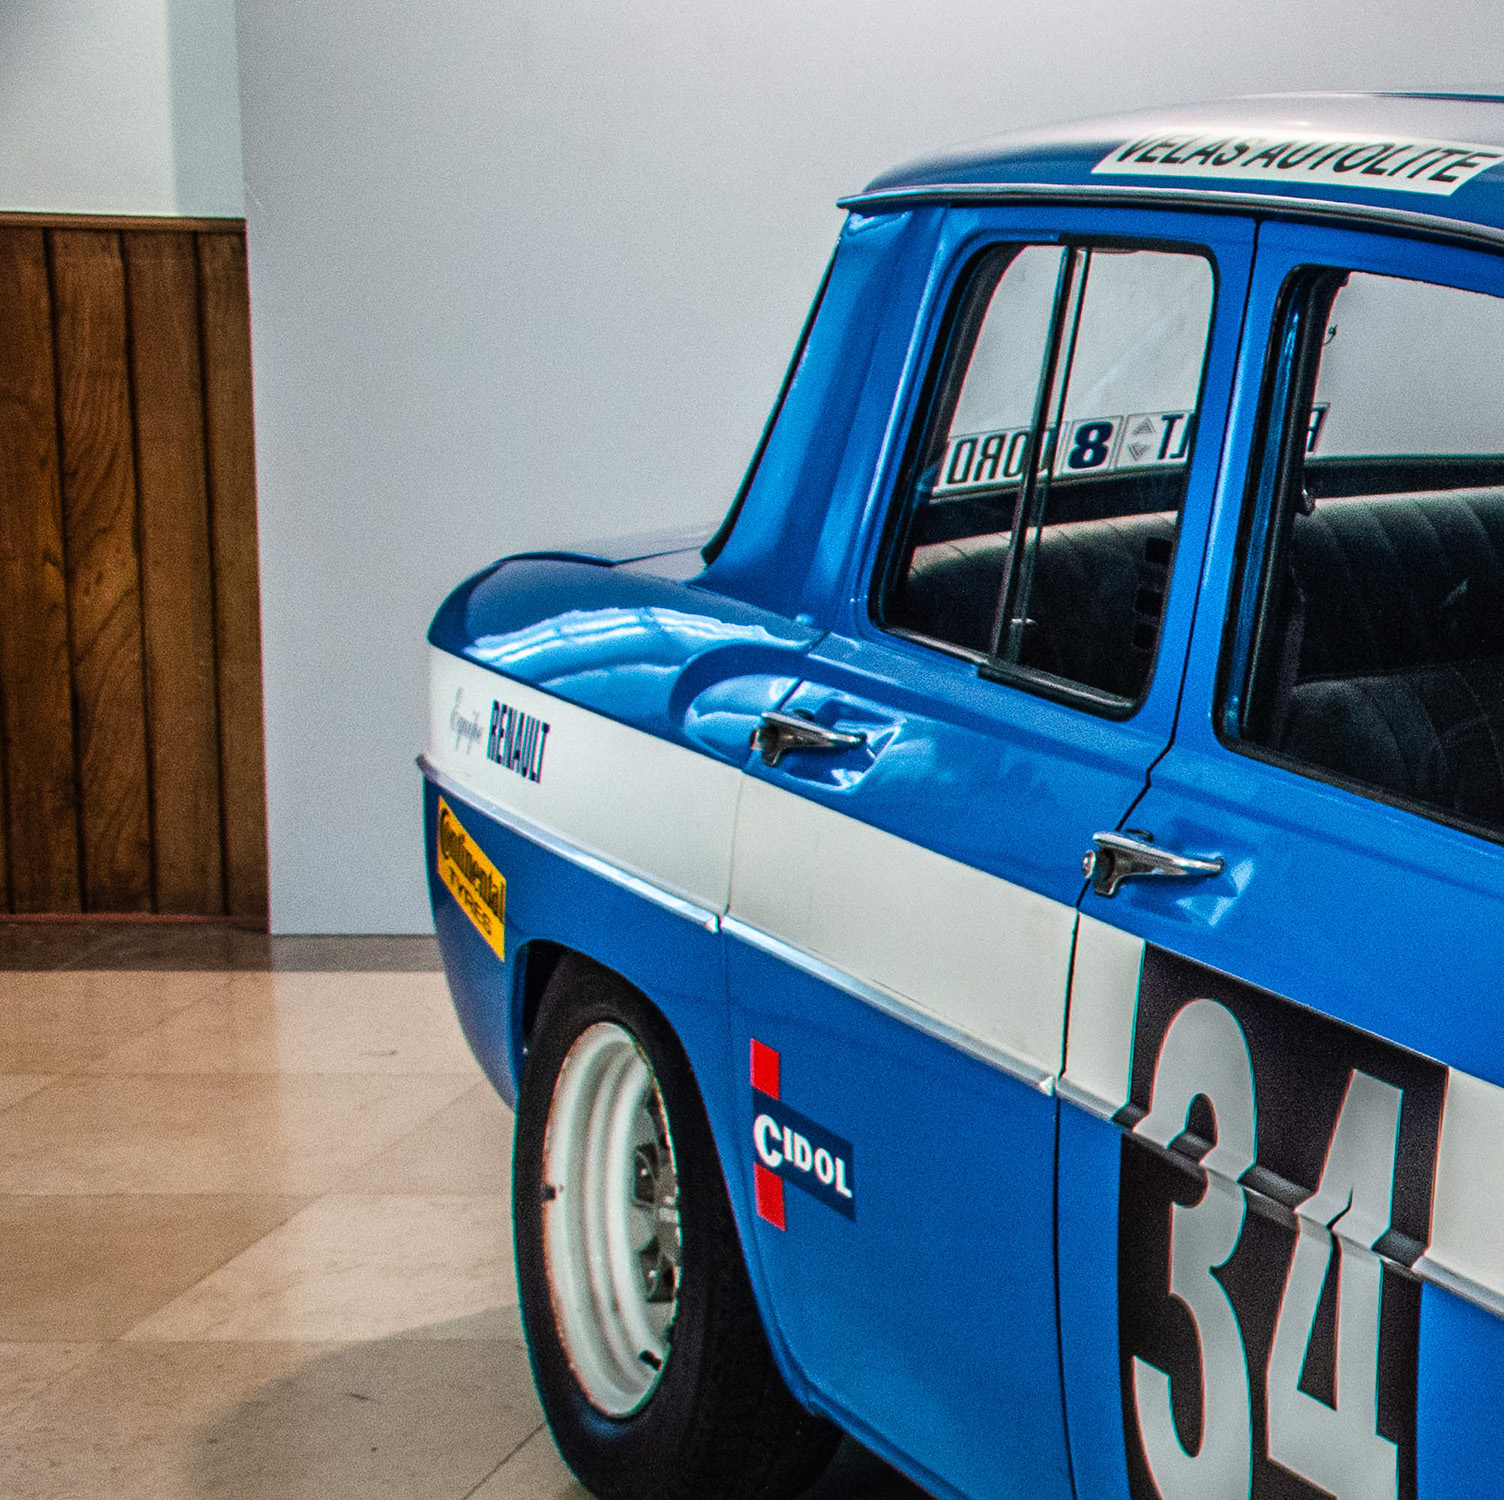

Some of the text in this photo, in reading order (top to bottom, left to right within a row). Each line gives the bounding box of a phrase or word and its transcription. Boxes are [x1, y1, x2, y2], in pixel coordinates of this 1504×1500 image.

[1117, 134, 1504, 183] VELAS AUTOLITE
[486, 699, 550, 784] RENAULT
[753, 1113, 853, 1198] CIDOL
